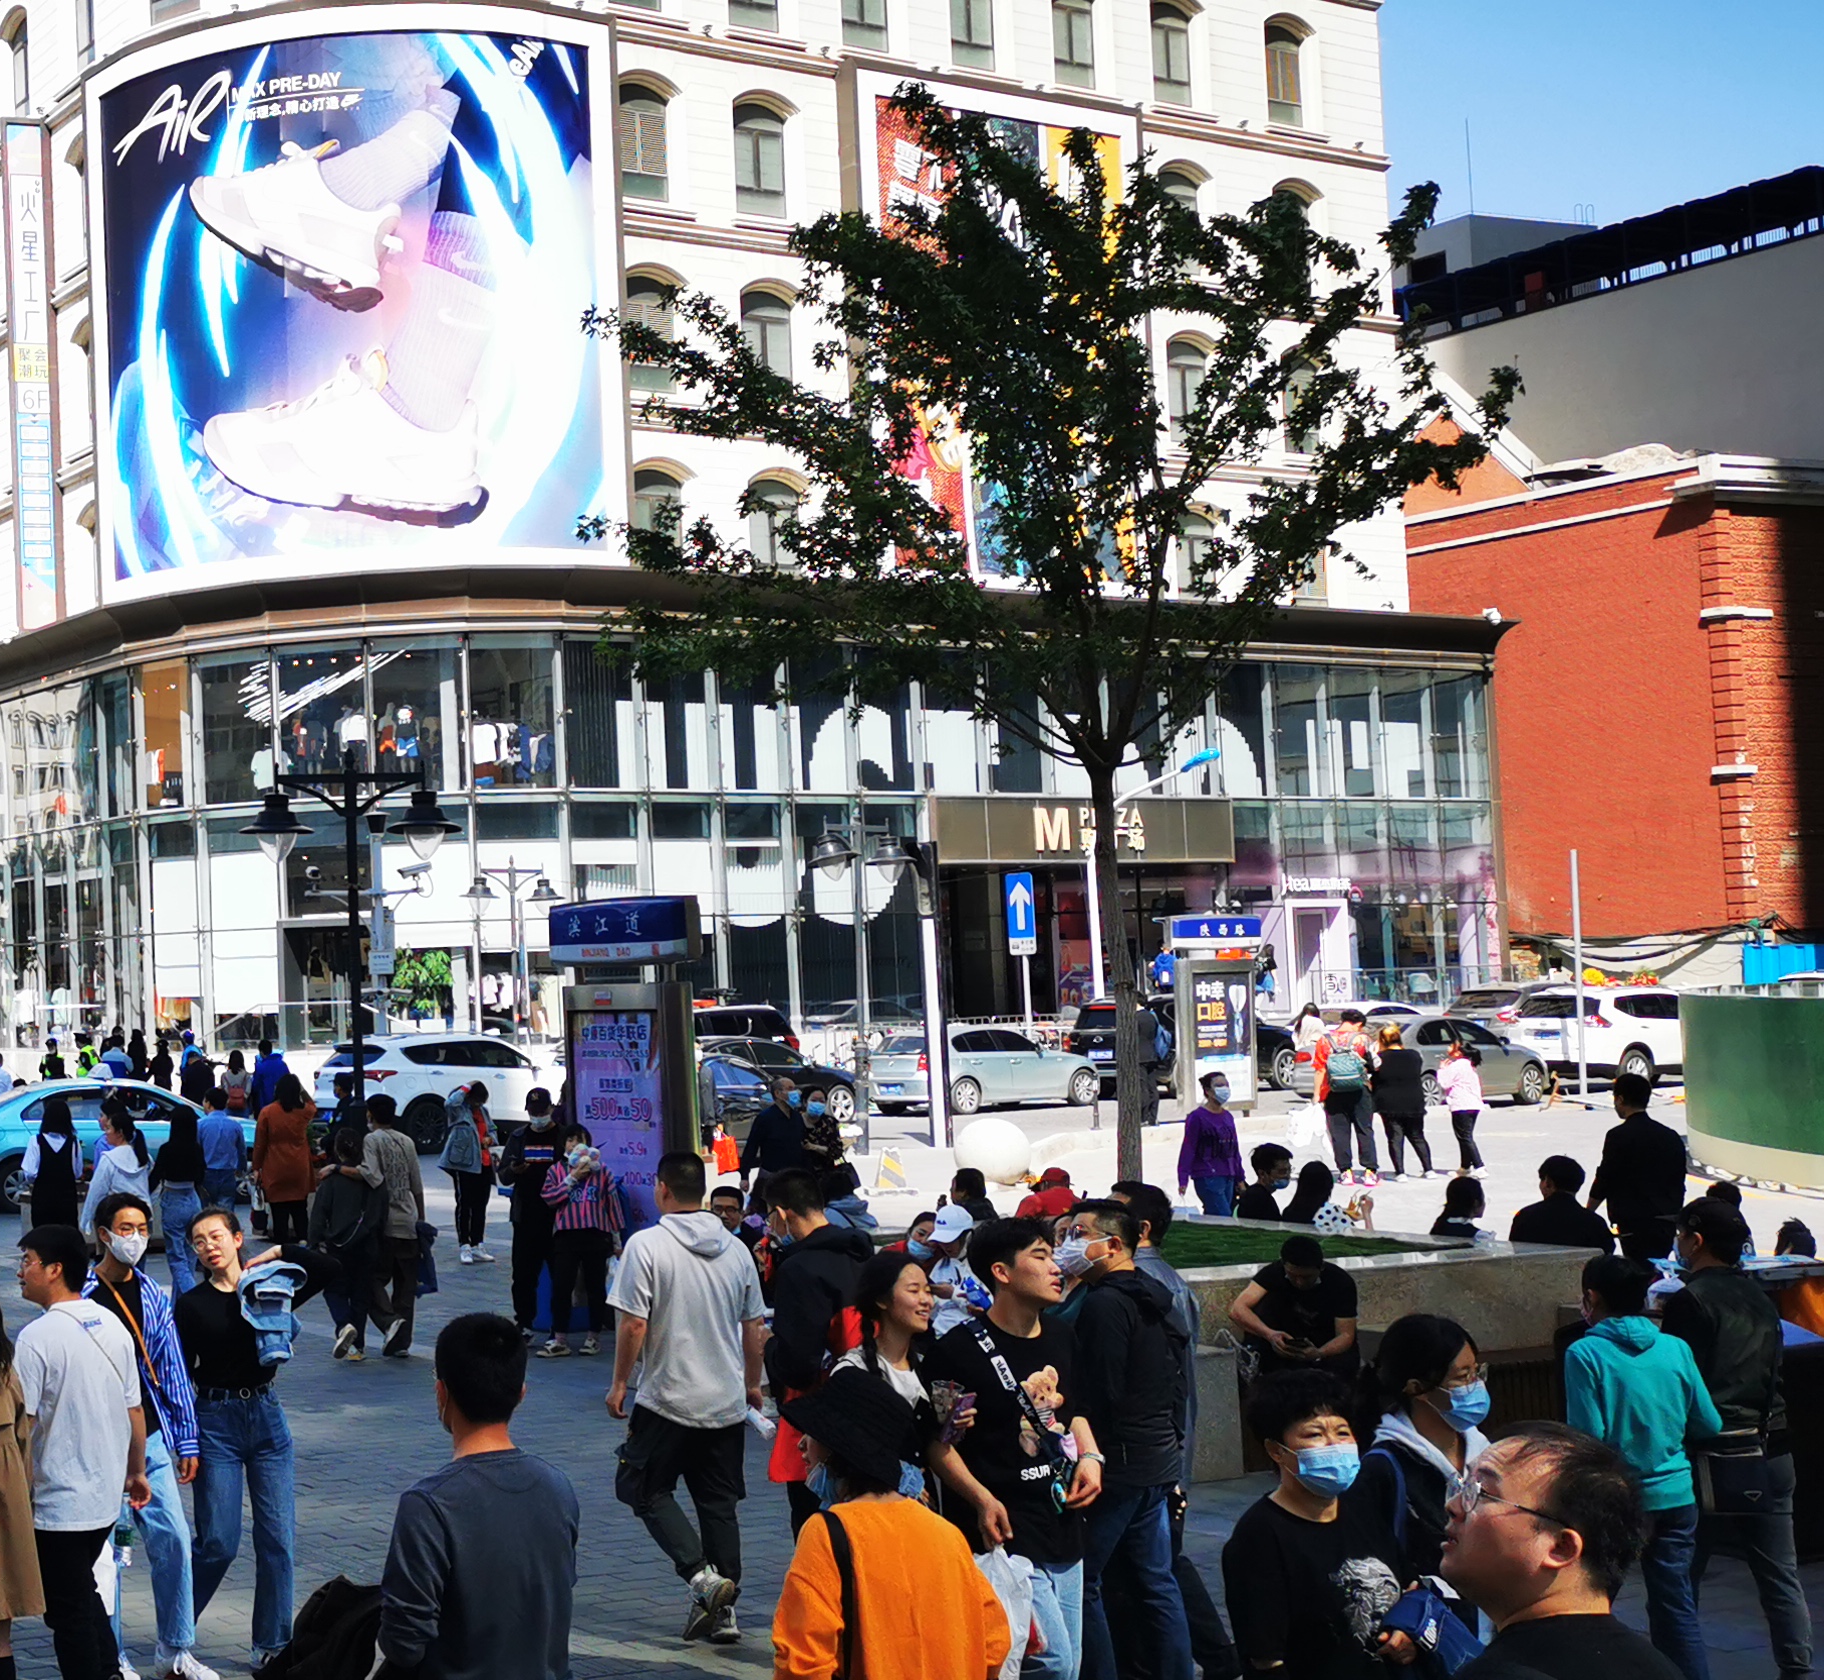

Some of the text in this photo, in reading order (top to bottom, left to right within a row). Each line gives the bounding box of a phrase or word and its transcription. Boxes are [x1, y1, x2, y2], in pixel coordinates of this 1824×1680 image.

[269, 72, 342, 94] PRE-DAY
[20, 191, 41, 342] 火星工厂
[22, 389, 48, 410] 6F
[1033, 807, 1144, 852] M PLZA
[568, 910, 643, 938] 滨江道
